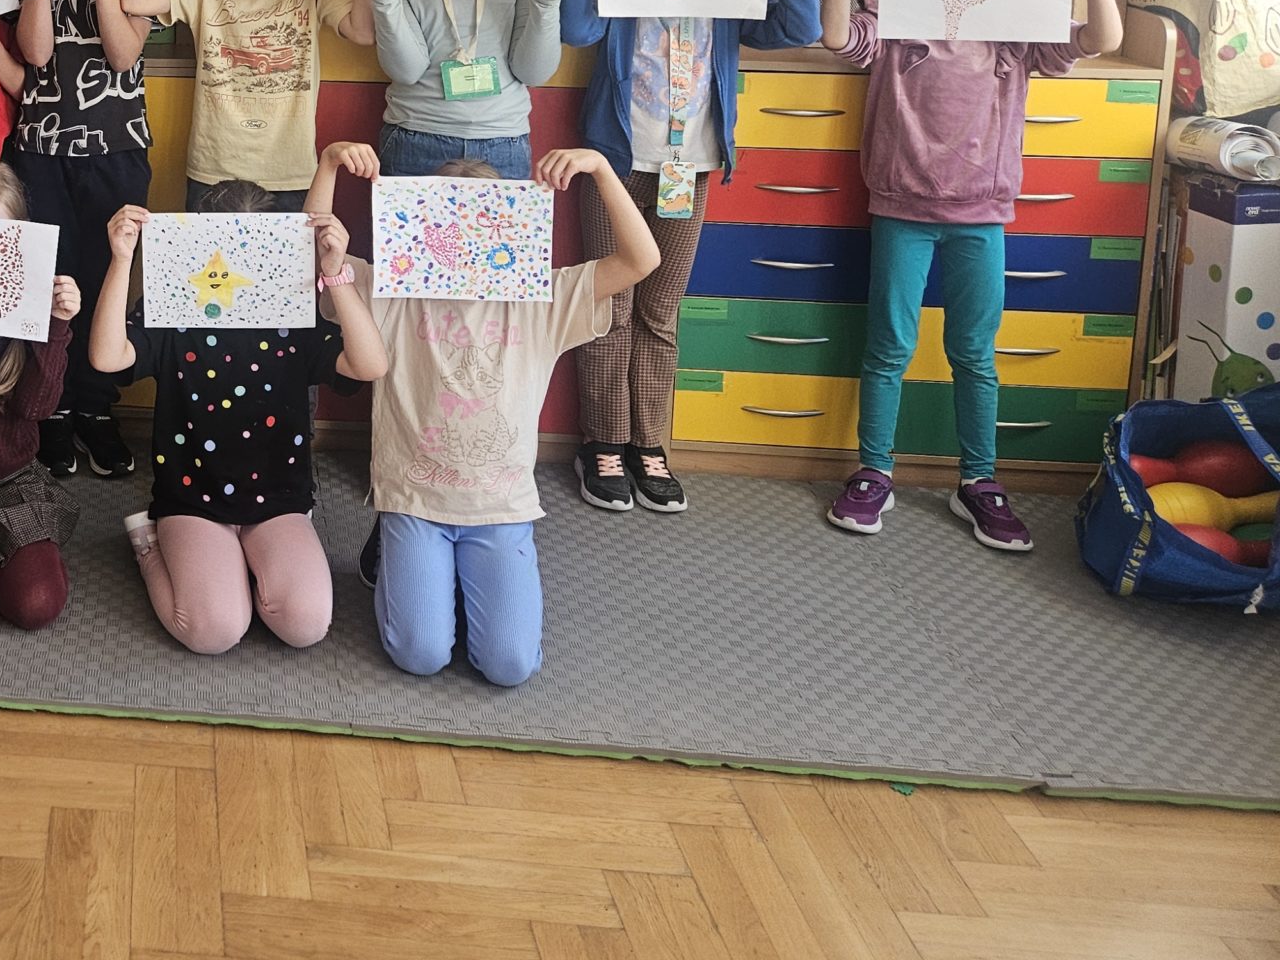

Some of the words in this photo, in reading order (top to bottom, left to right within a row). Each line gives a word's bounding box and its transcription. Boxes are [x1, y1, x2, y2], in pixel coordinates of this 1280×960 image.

[244, 119, 263, 129] Ford
[417, 310, 471, 348] Cute
[1222, 397, 1256, 431] IKEA
